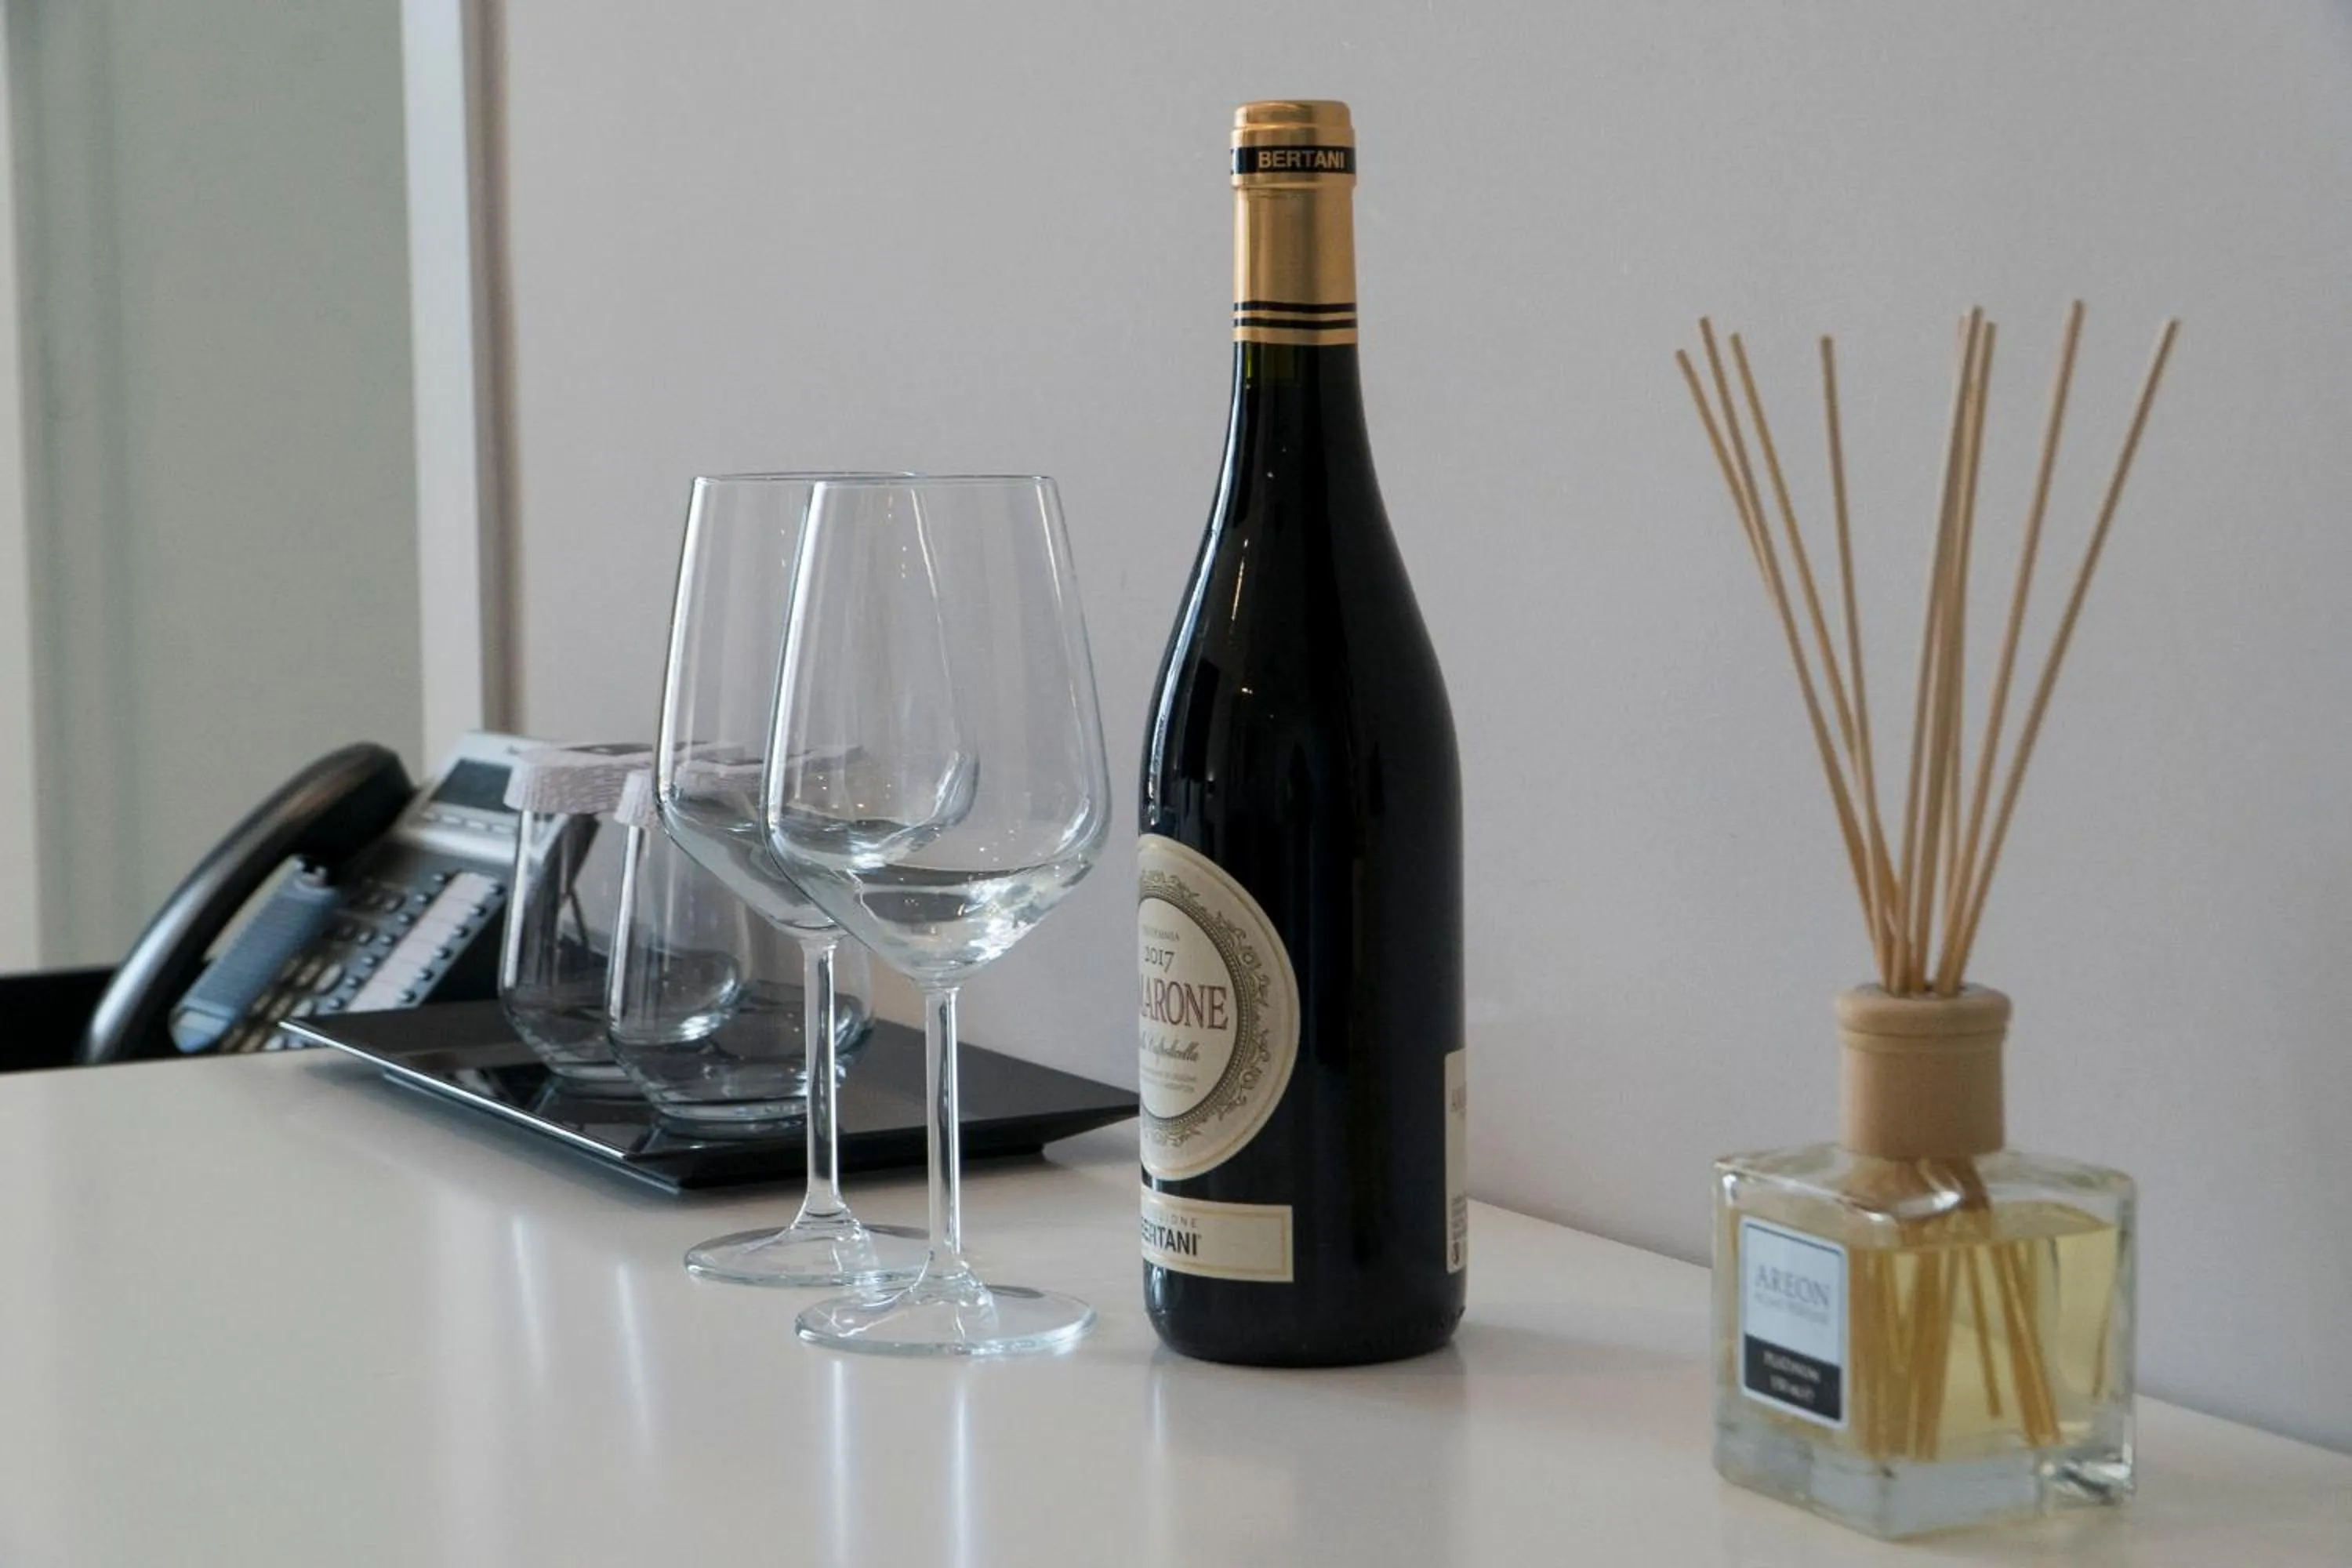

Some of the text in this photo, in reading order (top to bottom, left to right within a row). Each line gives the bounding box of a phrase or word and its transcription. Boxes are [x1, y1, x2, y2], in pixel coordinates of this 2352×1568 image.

[1258, 151, 1345, 169] BERTANI
[1144, 945, 1175, 974] 2017
[1755, 1263, 1830, 1308] AREON
